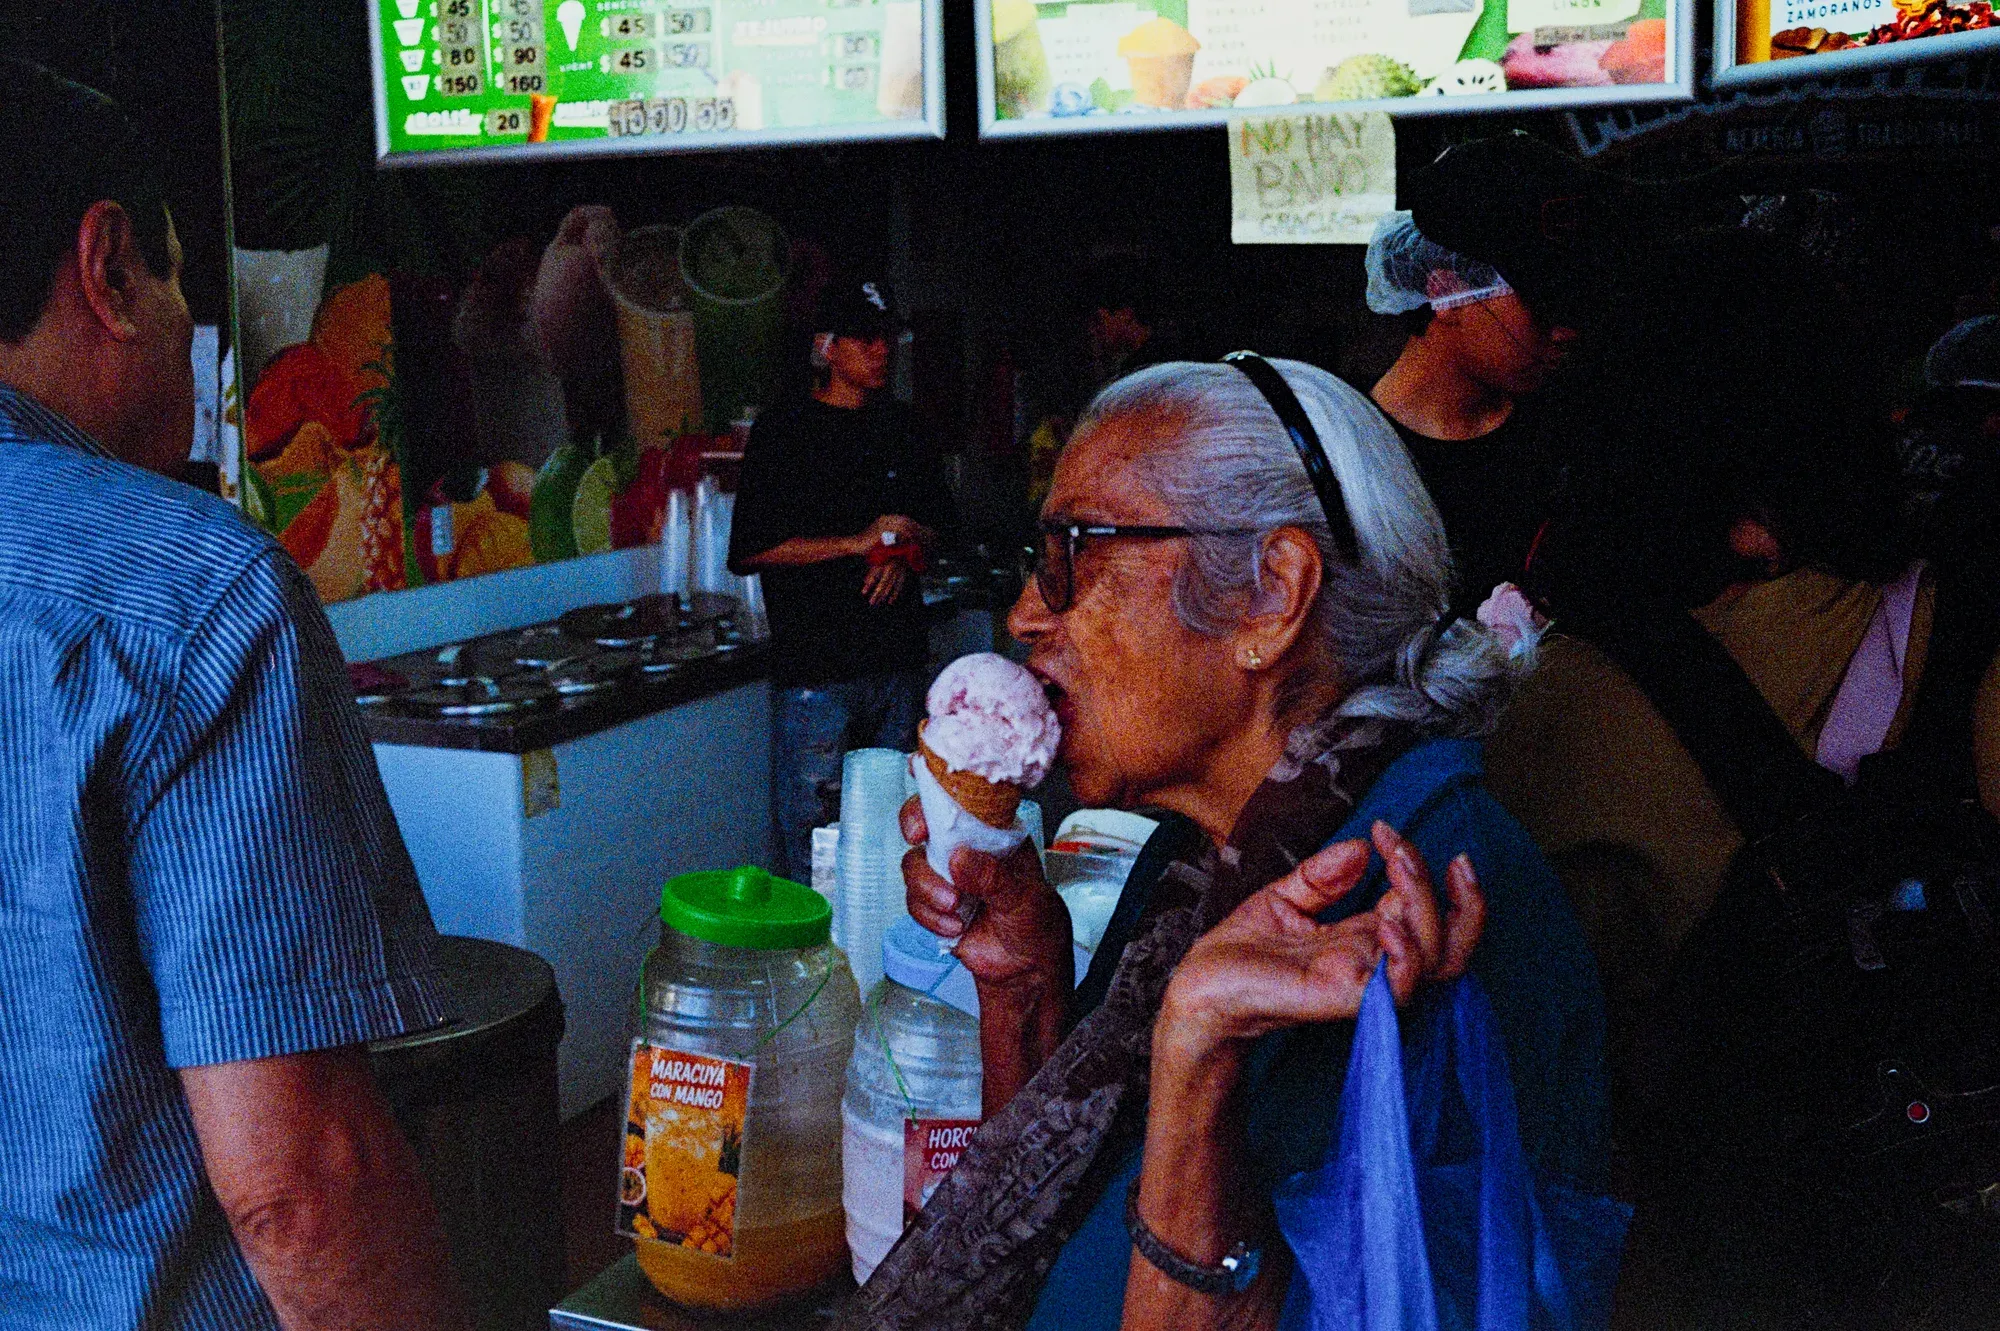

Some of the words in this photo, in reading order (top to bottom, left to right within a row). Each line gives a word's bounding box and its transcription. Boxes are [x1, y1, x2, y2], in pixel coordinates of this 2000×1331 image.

[1786, 0, 1880, 23] ZAMORANOS
[618, 18, 644, 34] 45
[450, 48, 475, 66] 80
[513, 48, 536, 65] 90
[619, 51, 646, 69] 45
[445, 75, 478, 94] 150
[510, 75, 542, 93] 160
[497, 113, 519, 131] 20
[1241, 118, 1293, 157] NO
[1304, 111, 1368, 162] HAY
[650, 1082, 672, 1100] CON
[673, 1086, 724, 1110] MANGO
[928, 1126, 977, 1149] HORC
[930, 1151, 959, 1170] CON
